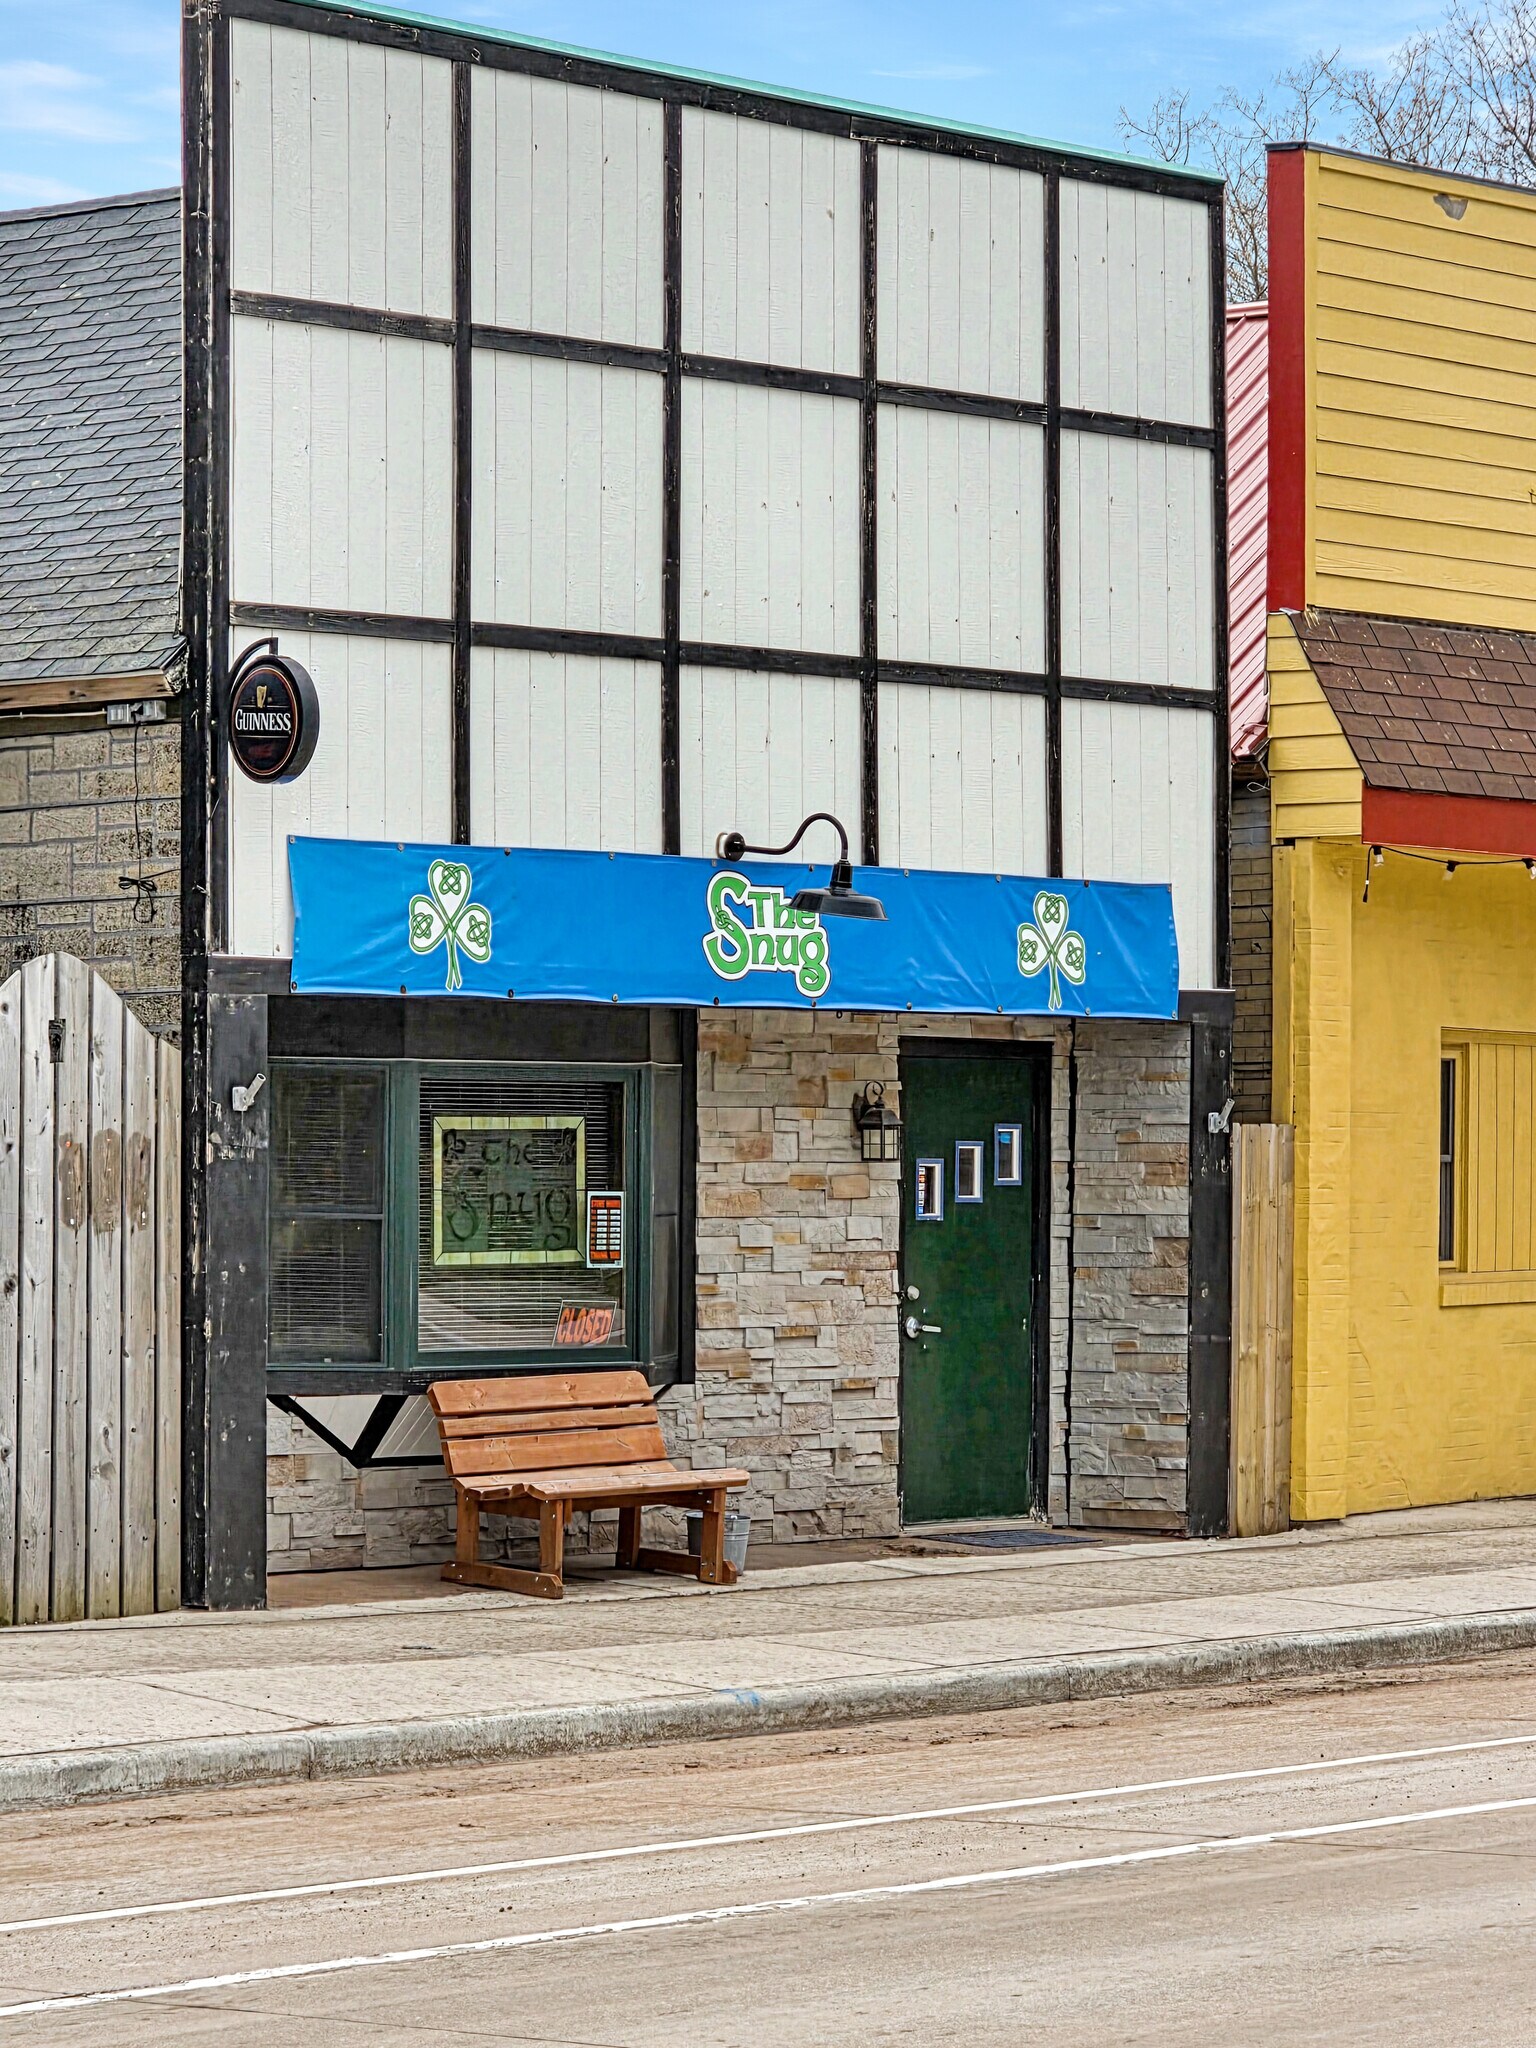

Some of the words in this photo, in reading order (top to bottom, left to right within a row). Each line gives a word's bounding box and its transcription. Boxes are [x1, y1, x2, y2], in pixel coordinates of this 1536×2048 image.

[235, 708, 291, 731] GUINNESS
[747, 891, 816, 929] The
[707, 876, 827, 992] Snug
[557, 1307, 613, 1344] CLOSED
